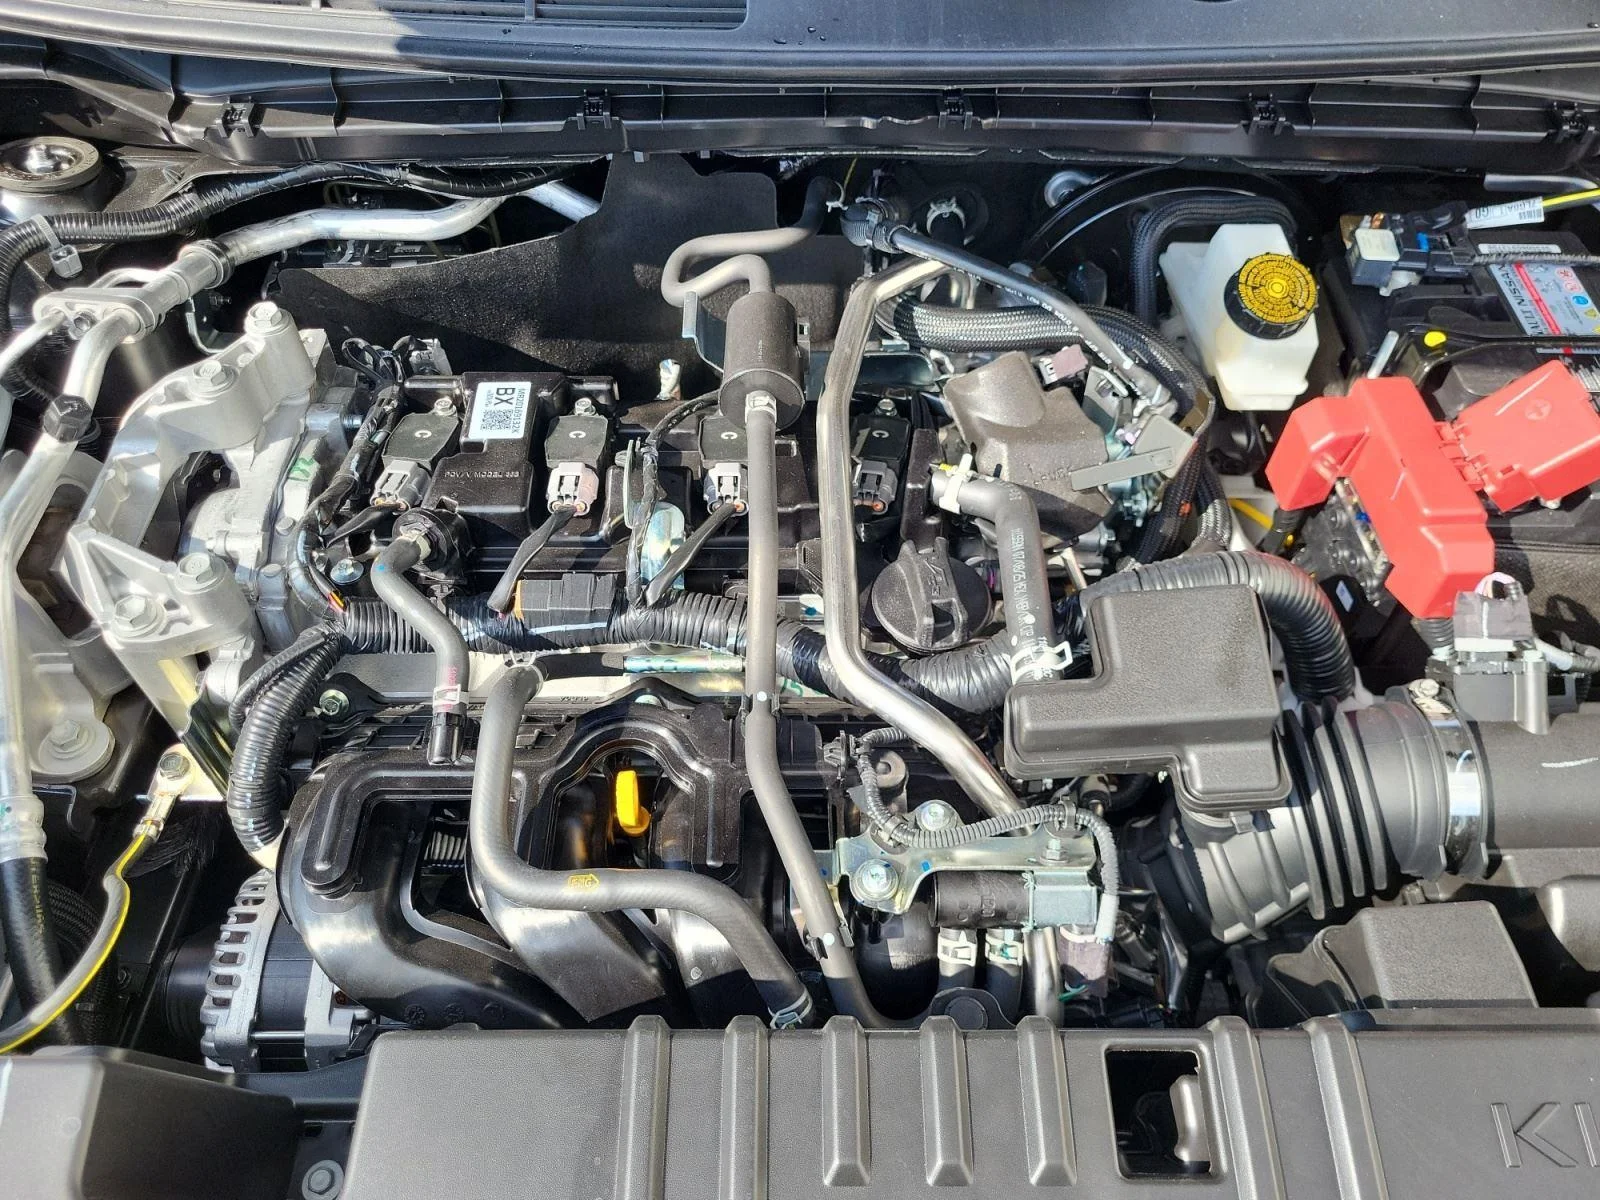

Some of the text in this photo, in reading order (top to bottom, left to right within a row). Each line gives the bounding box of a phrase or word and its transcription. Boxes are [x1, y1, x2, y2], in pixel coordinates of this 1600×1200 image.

[493, 387, 516, 406] BX
[414, 429, 432, 439] C
[568, 430, 587, 439] C
[720, 431, 738, 440] C
[872, 429, 890, 439] C
